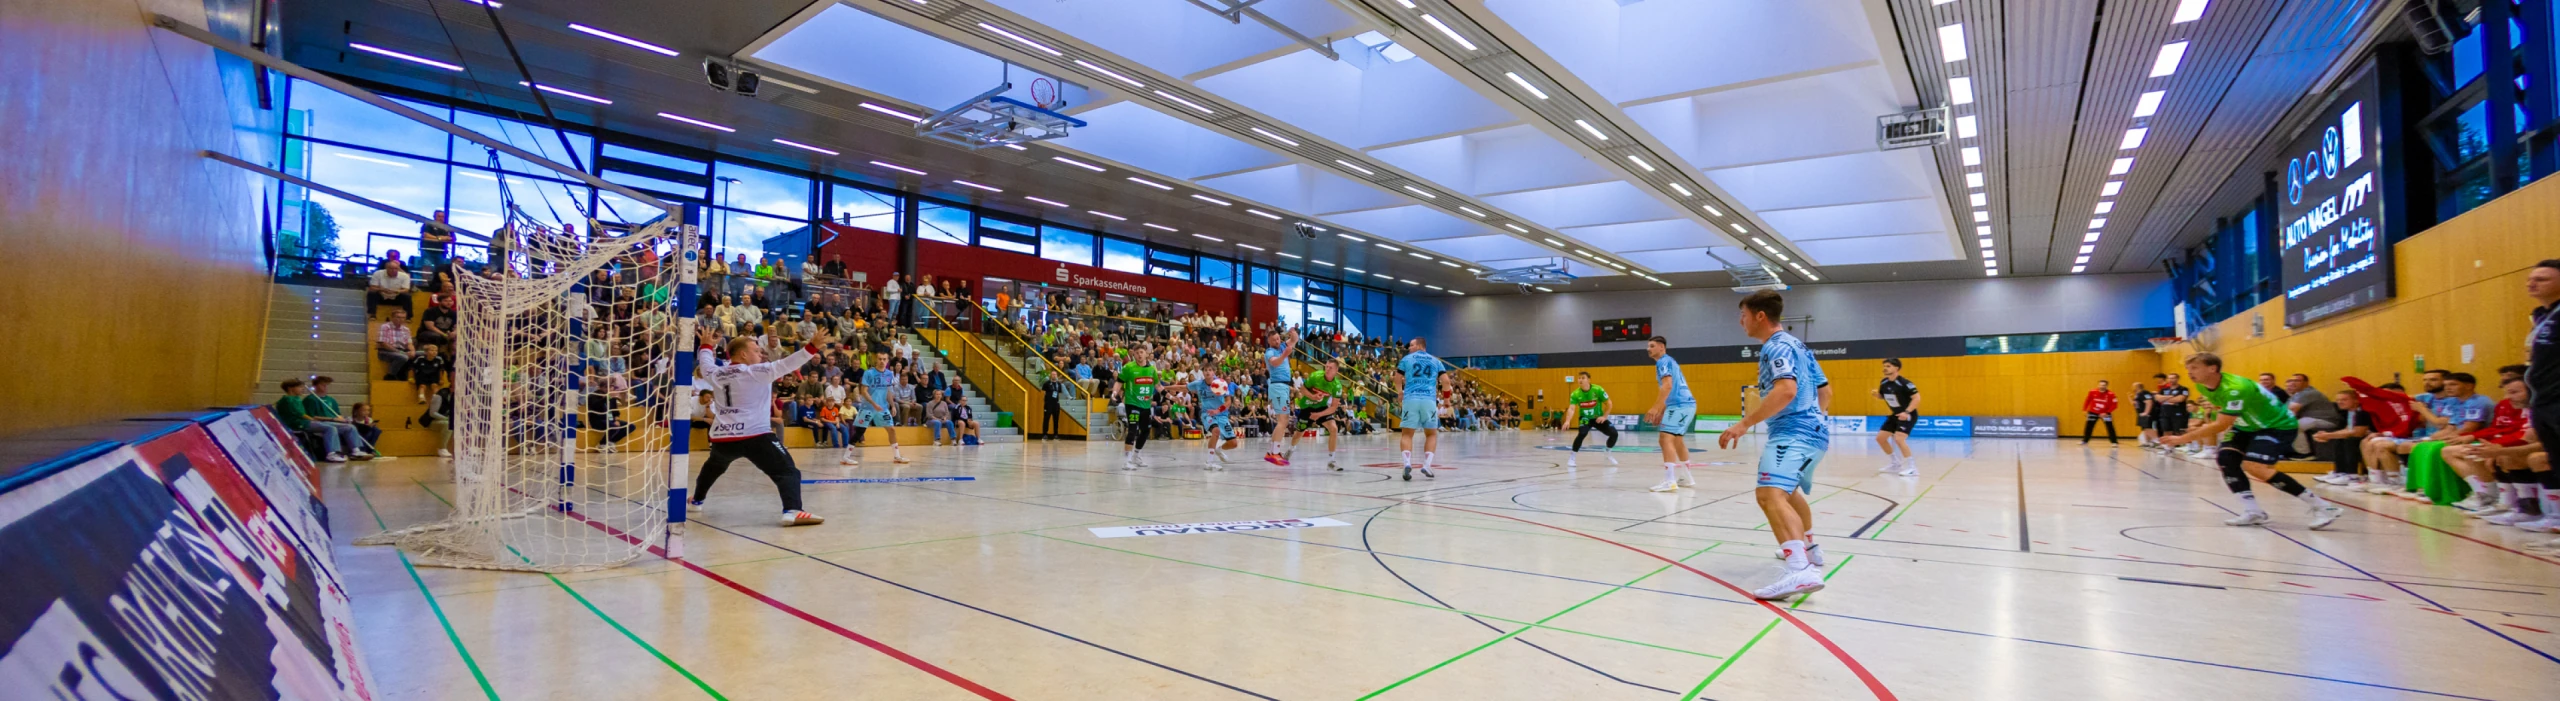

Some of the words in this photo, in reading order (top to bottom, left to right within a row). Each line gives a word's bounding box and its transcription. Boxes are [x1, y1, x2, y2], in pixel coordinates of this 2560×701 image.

[2286, 216, 2307, 249] AUTO
[2308, 195, 2340, 236] NAGEL
[687, 225, 697, 249] artec
[1073, 274, 1147, 294] SparkassenArena
[1413, 363, 1431, 378] 24
[724, 384, 731, 407] 1
[1139, 386, 1150, 394] 25
[1128, 413, 1139, 422] 25
[720, 422, 744, 432] sera
[1135, 522, 1314, 536] GRONAU
